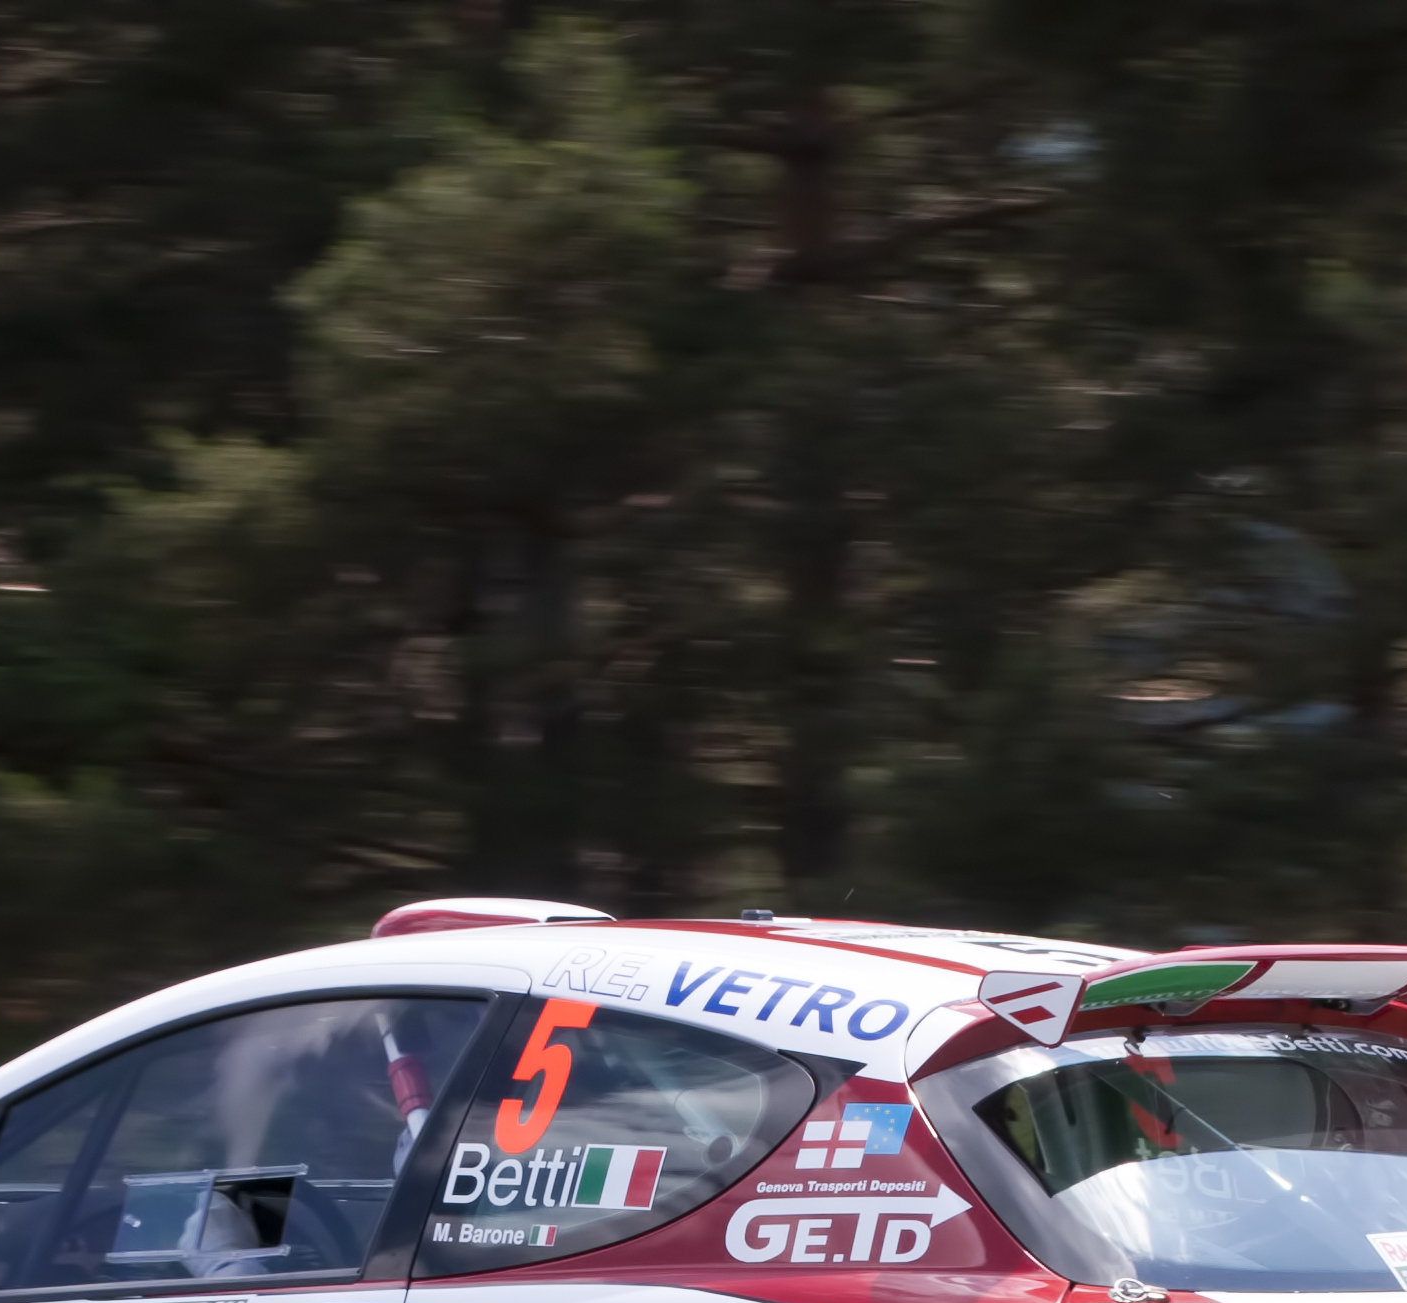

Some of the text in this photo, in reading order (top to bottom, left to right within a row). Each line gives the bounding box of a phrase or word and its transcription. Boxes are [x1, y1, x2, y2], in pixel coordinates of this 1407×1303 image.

[665, 960, 911, 1041] VETRO
[495, 998, 600, 1154] 5
[443, 1143, 582, 1207] Betti
[757, 1180, 926, 1194] Genova Trasporti Depositi
[433, 1223, 525, 1245] M. Barone
